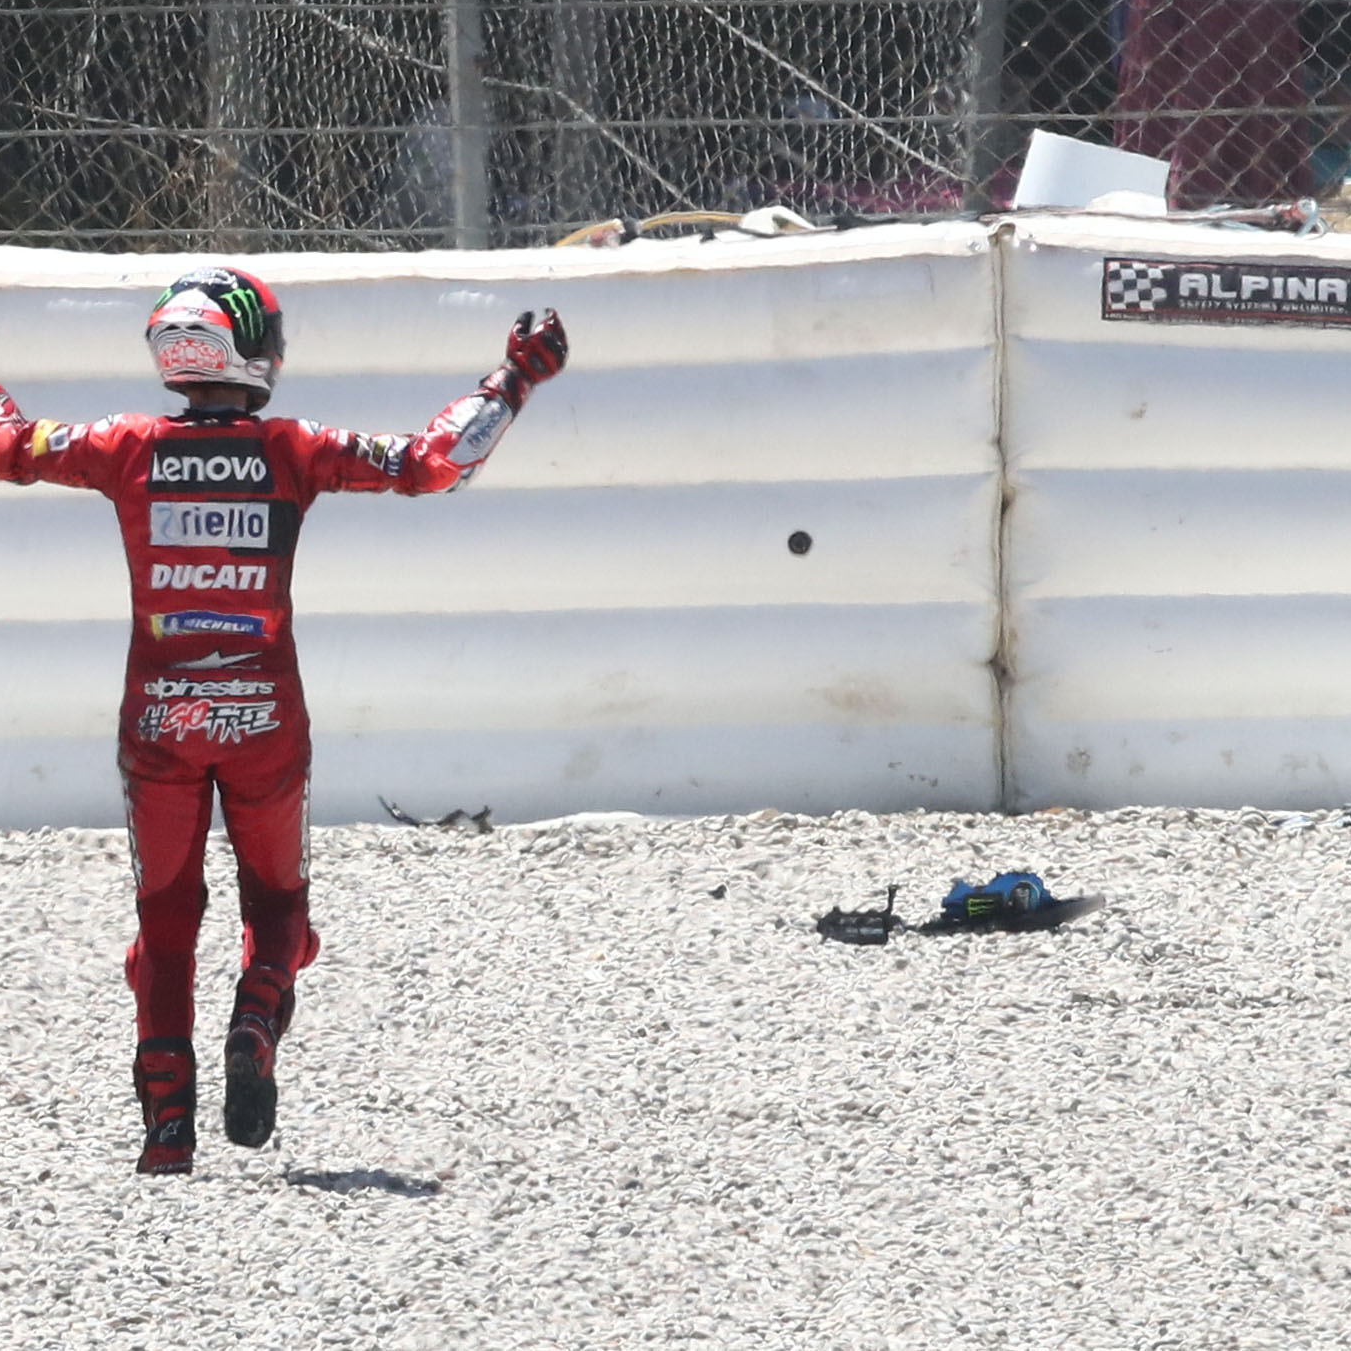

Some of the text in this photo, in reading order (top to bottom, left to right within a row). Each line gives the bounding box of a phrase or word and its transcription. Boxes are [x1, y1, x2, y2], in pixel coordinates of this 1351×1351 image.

[1178, 273, 1350, 302] ALPINA
[152, 452, 267, 483] Lenovo
[182, 506, 264, 538] riello
[151, 564, 267, 590] DUCATI
[183, 617, 256, 633] MICHELIN
[144, 676, 276, 700] alpinestars
